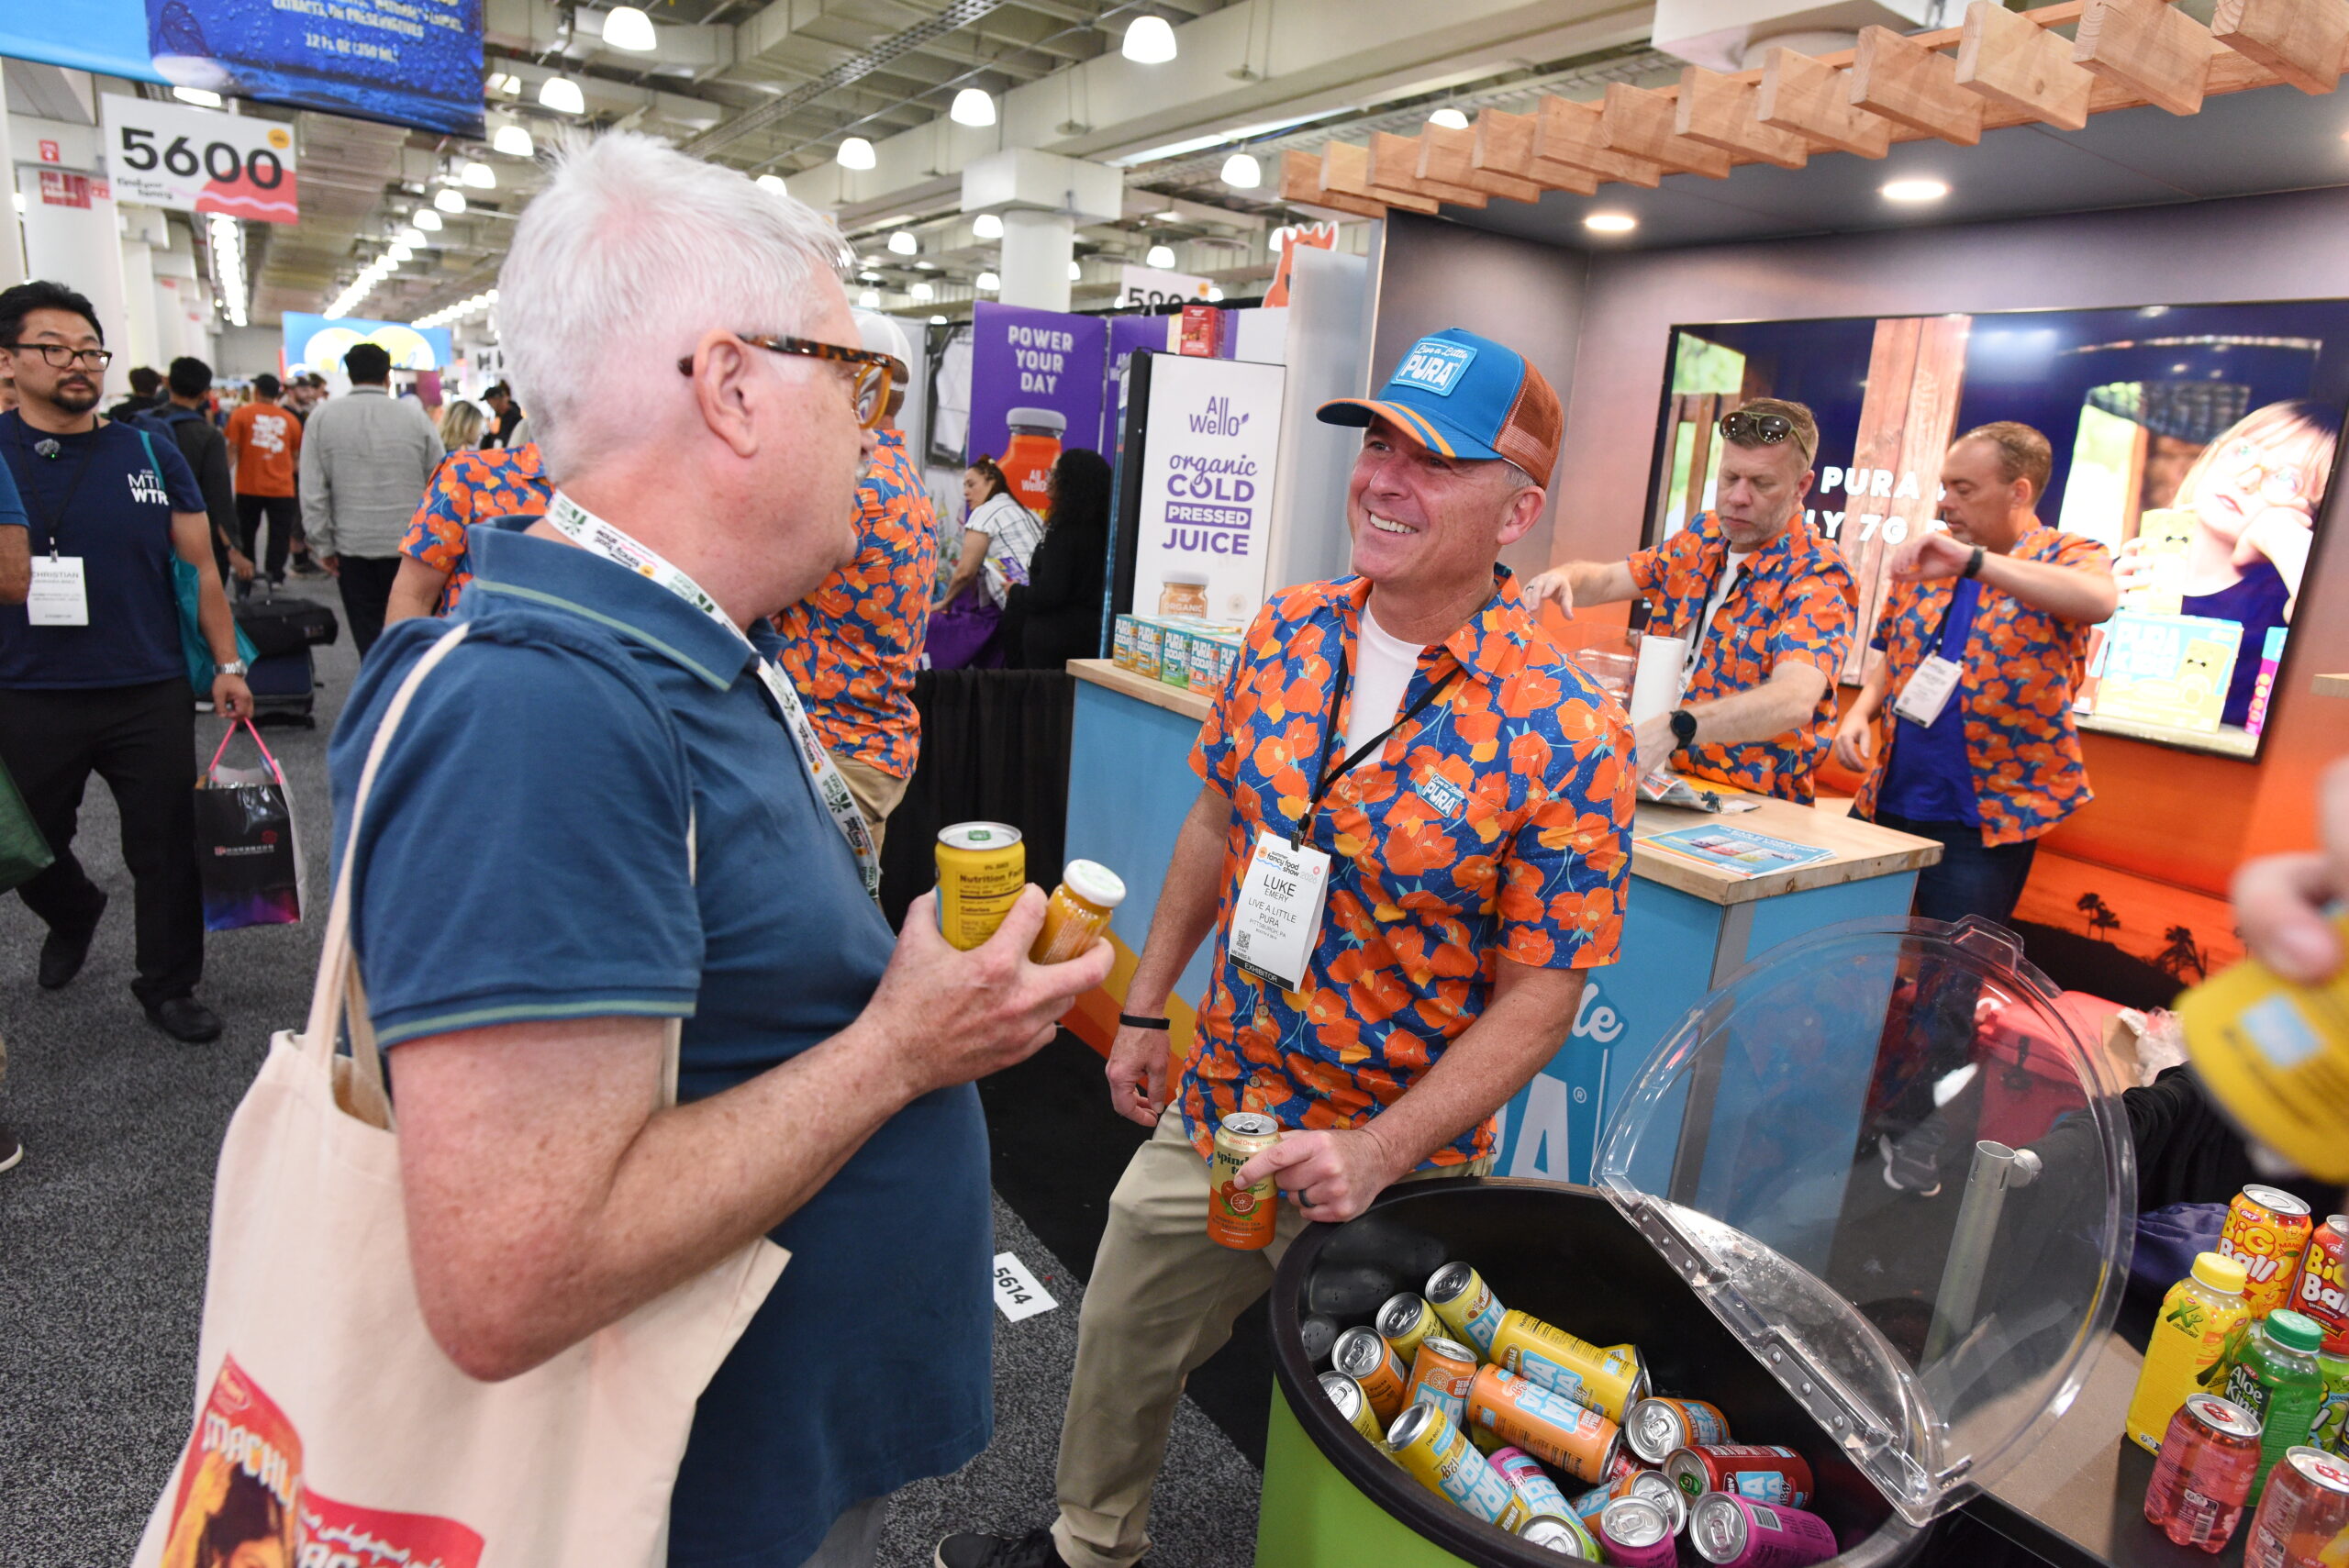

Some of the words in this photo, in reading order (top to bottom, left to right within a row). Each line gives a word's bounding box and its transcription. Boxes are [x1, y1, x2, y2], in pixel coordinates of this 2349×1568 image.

[121, 127, 283, 190] 5600
[1008, 325, 1074, 352] POWER
[1015, 349, 1063, 373] YOUR
[1400, 354, 1455, 386] PURA
[1019, 372, 1057, 395] DAY
[1169, 454, 1258, 485] organic
[1167, 473, 1254, 502] COLD
[1820, 466, 1920, 500] PURA
[130, 487, 170, 506] WTR
[1167, 505, 1249, 526] PRESSED
[1859, 513, 1909, 545] 7G
[1162, 528, 1250, 556] JUICE
[1116, 617, 1131, 634] PURA
[1138, 625, 1154, 642] PURA
[1165, 631, 1185, 651] PURA
[1192, 639, 1212, 658] PURA
[1220, 647, 1237, 666] PUR
[1421, 782, 1456, 815] PURA
[1267, 852, 1285, 866] fancy
[1285, 860, 1300, 871] food
[1282, 866, 1300, 877] show
[960, 873, 1006, 884] Nutrition
[1264, 873, 1297, 897] LUKE
[1264, 888, 1289, 903] EMERY
[1247, 896, 1264, 909] LIVE
[1264, 905, 1272, 913] A
[1271, 906, 1297, 923] LITTLE
[1258, 912, 1280, 928] PURA
[1244, 962, 1278, 983] EXHIBITOR
[1572, 983, 1623, 1043] le
[1217, 1150, 1250, 1165] spind
[2240, 1209, 2258, 1221] OKF
[2219, 1237, 2278, 1283] Ball
[994, 1267, 1033, 1305] 5614
[2308, 1302, 2339, 1319] Strawberry
[1469, 1297, 1506, 1349] PUR
[2243, 1363, 2259, 1380] OKF
[2230, 1365, 2264, 1404] Aloe
[1441, 1456, 1460, 1481] 12g
